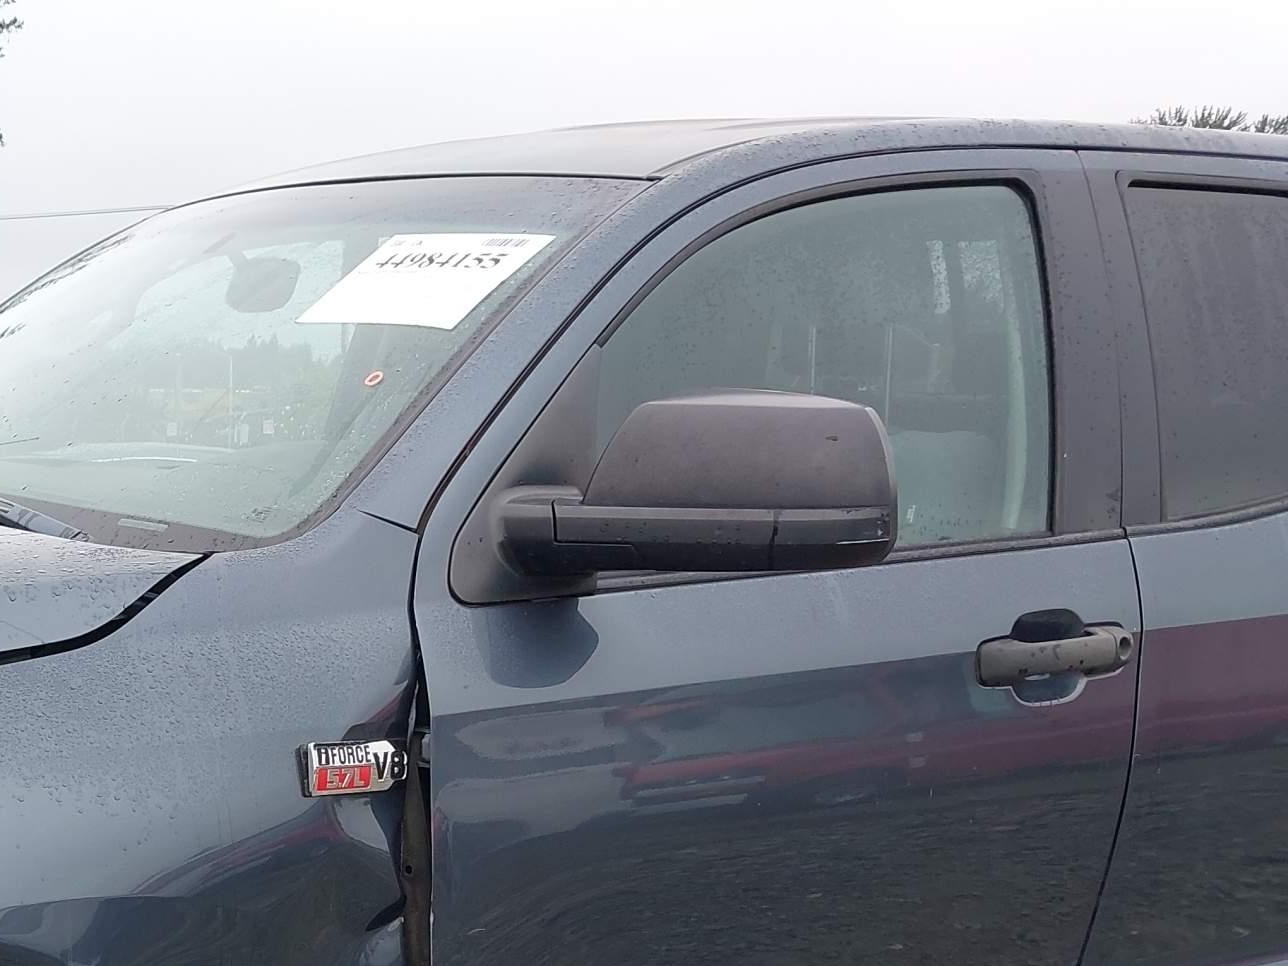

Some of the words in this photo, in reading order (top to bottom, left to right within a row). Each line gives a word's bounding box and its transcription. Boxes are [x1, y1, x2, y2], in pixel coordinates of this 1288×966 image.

[376, 252, 509, 268] 44984155
[326, 766, 366, 789] 5.7L
[373, 750, 408, 782] V8
